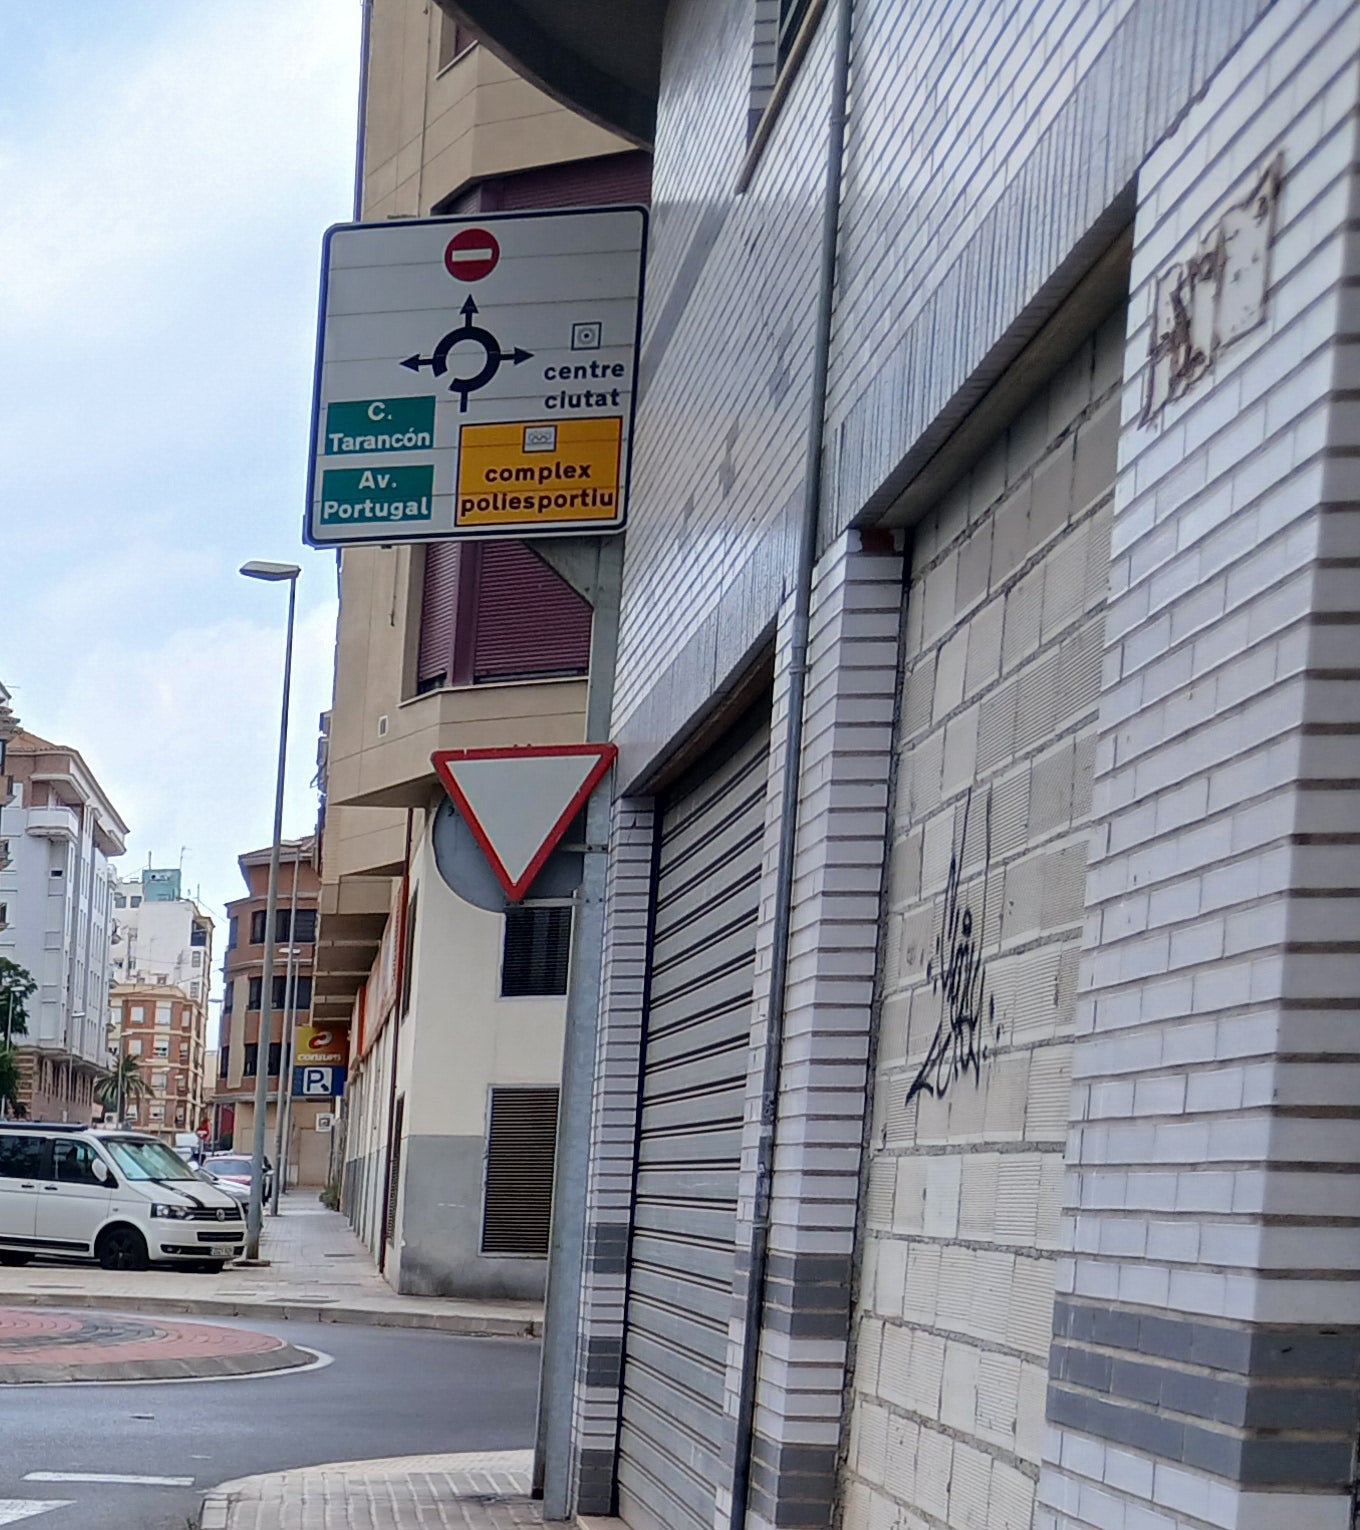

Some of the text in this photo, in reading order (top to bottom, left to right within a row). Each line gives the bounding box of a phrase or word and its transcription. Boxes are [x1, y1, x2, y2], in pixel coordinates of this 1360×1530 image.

[544, 360, 625, 381] centre
[544, 388, 620, 410] ciutat
[367, 401, 392, 421] C.
[329, 428, 432, 452] Tarancón
[358, 470, 397, 489] Av.
[484, 462, 592, 484] complex
[323, 497, 429, 521] Portugal
[460, 490, 614, 517] poliesportiu
